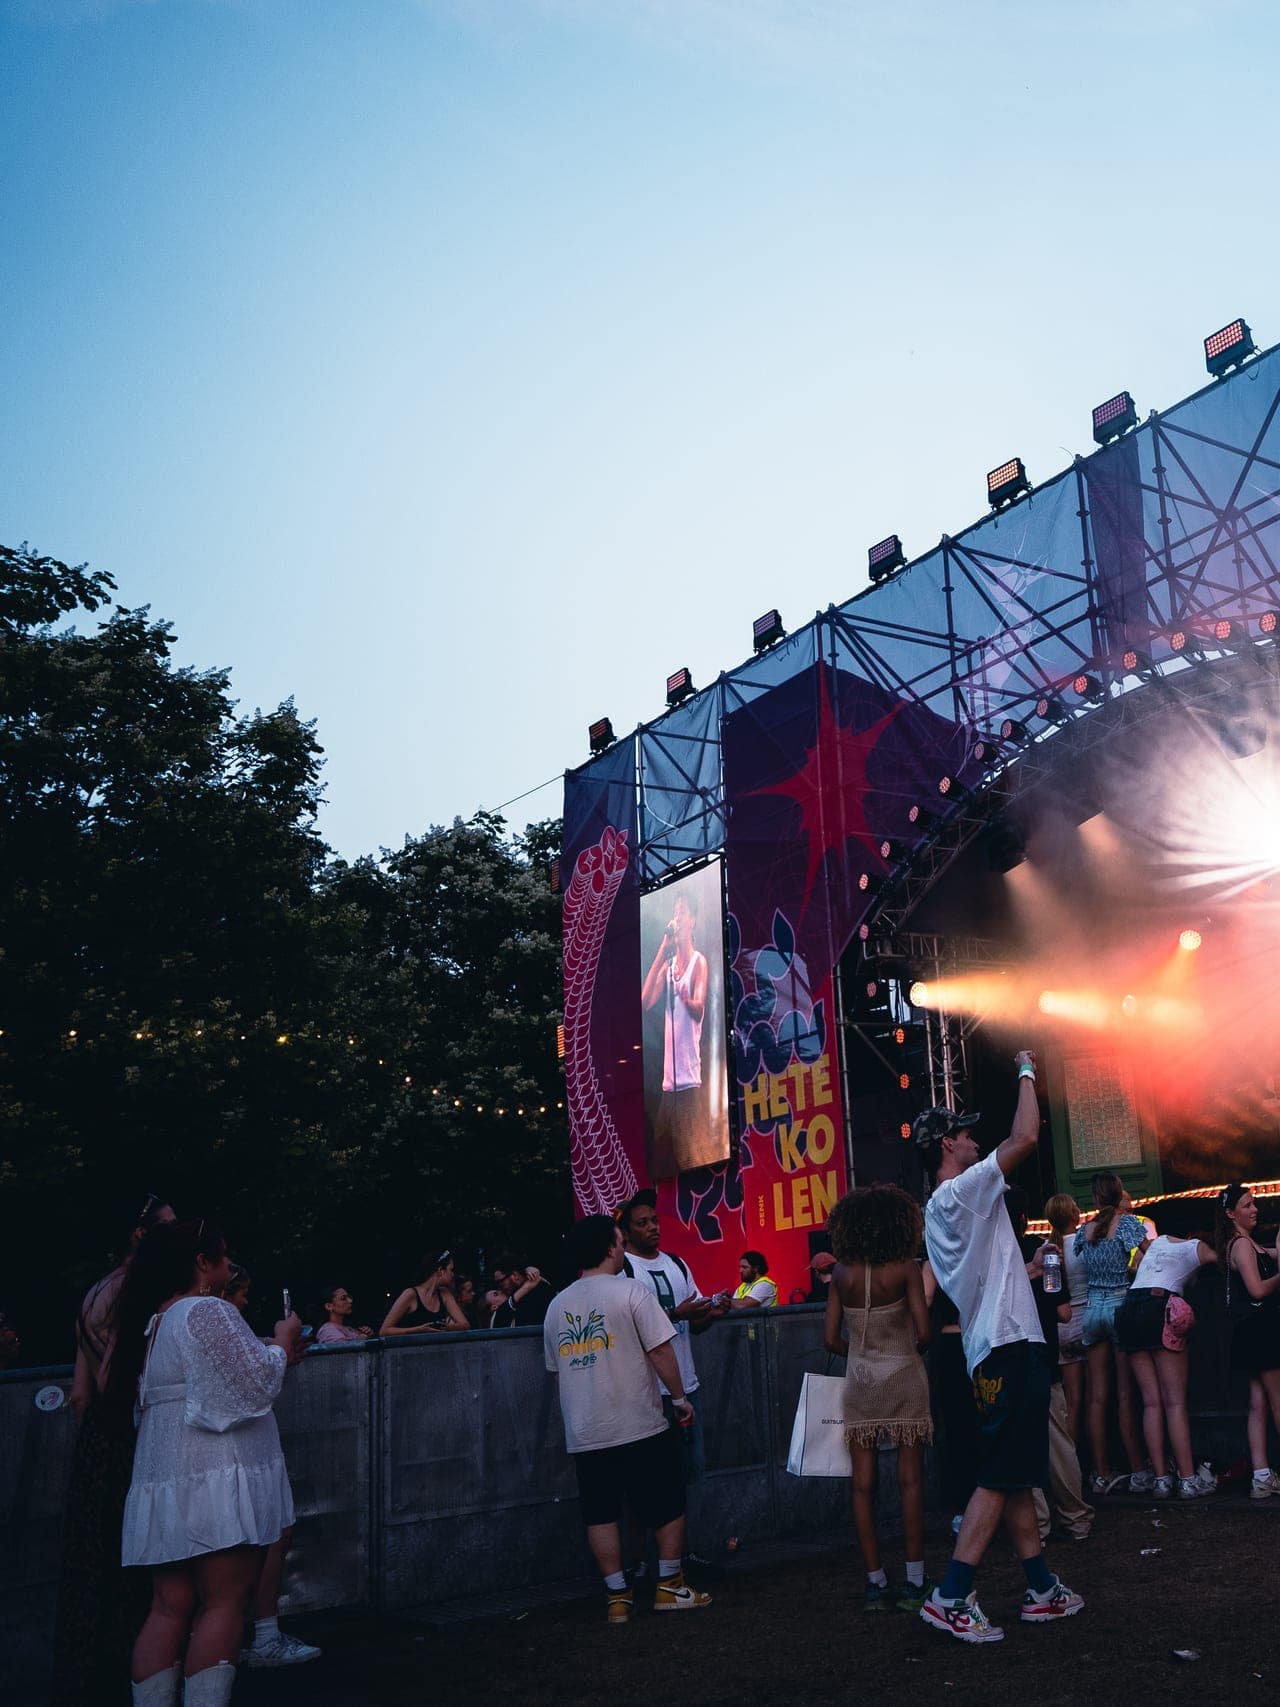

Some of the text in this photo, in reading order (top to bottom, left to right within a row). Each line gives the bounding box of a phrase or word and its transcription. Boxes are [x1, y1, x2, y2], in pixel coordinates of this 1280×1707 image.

[743, 1053, 833, 1125] HETE
[778, 1113, 835, 1173] KO
[758, 1194, 766, 1228] GENK
[773, 1170, 838, 1231] LEN
